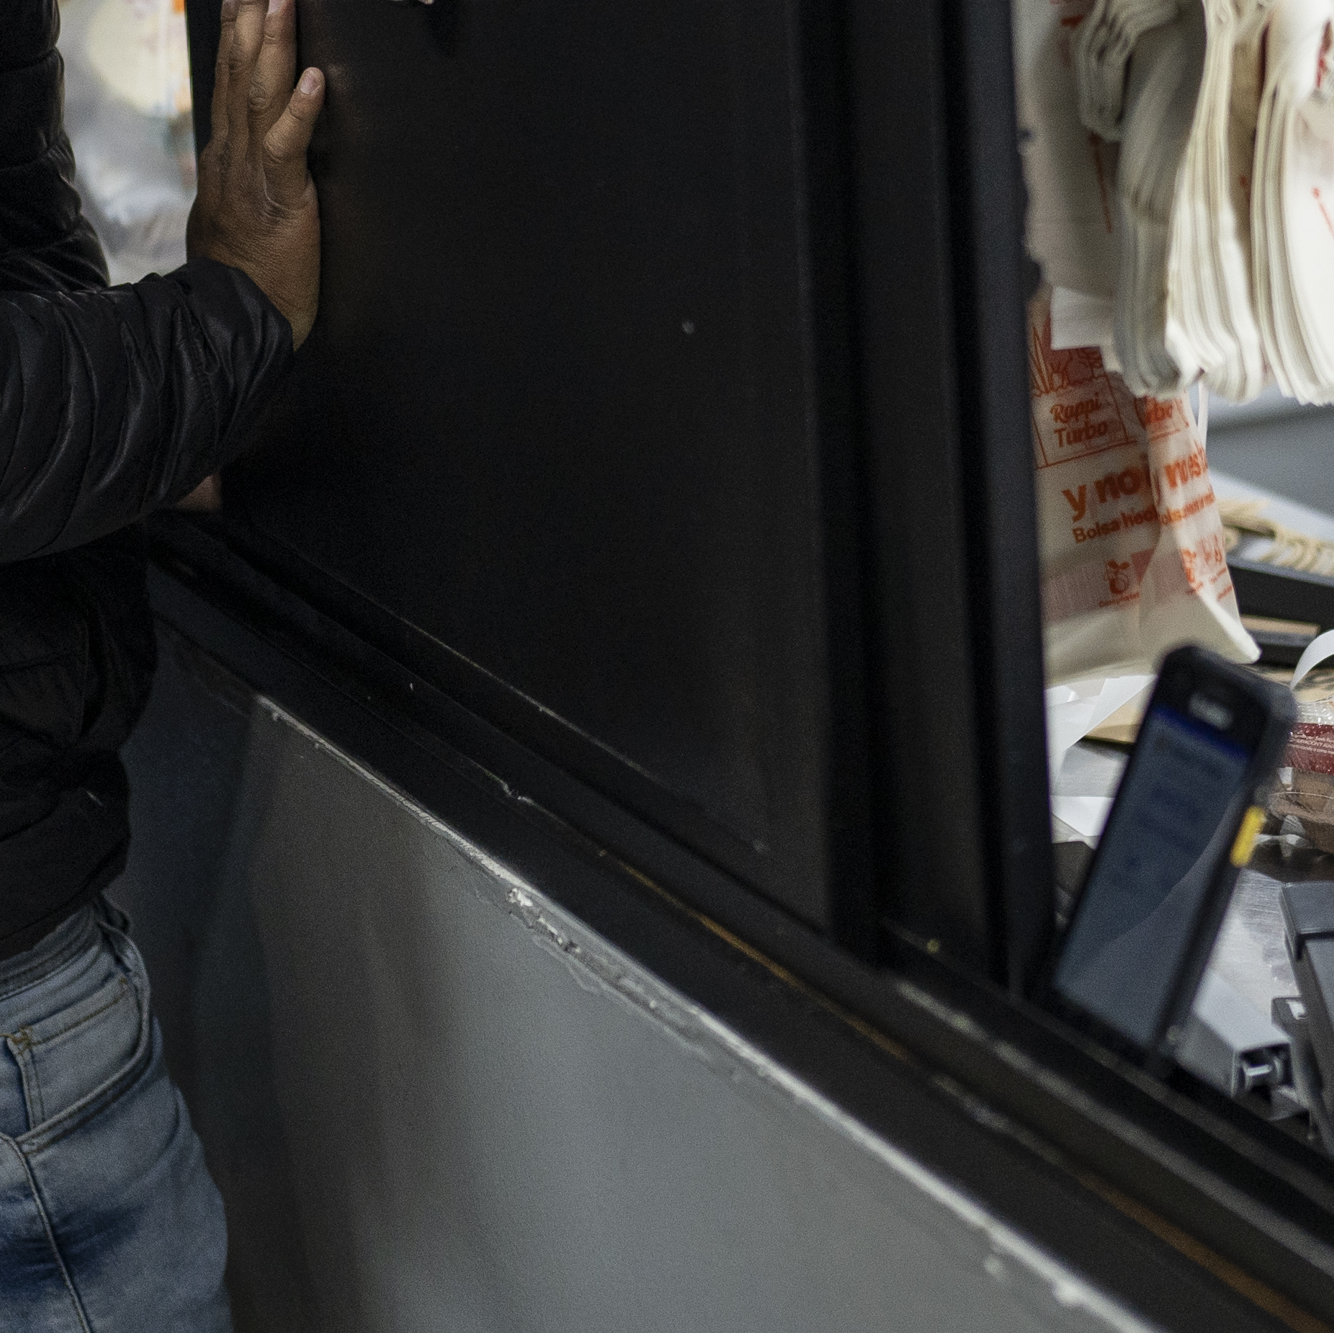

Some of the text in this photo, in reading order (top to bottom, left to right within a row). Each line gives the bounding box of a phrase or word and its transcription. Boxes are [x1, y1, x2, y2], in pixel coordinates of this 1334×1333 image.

[1050, 392, 1102, 425] Rappi
[1053, 419, 1108, 448] Turbo
[1072, 515, 1121, 544] Bolsa
